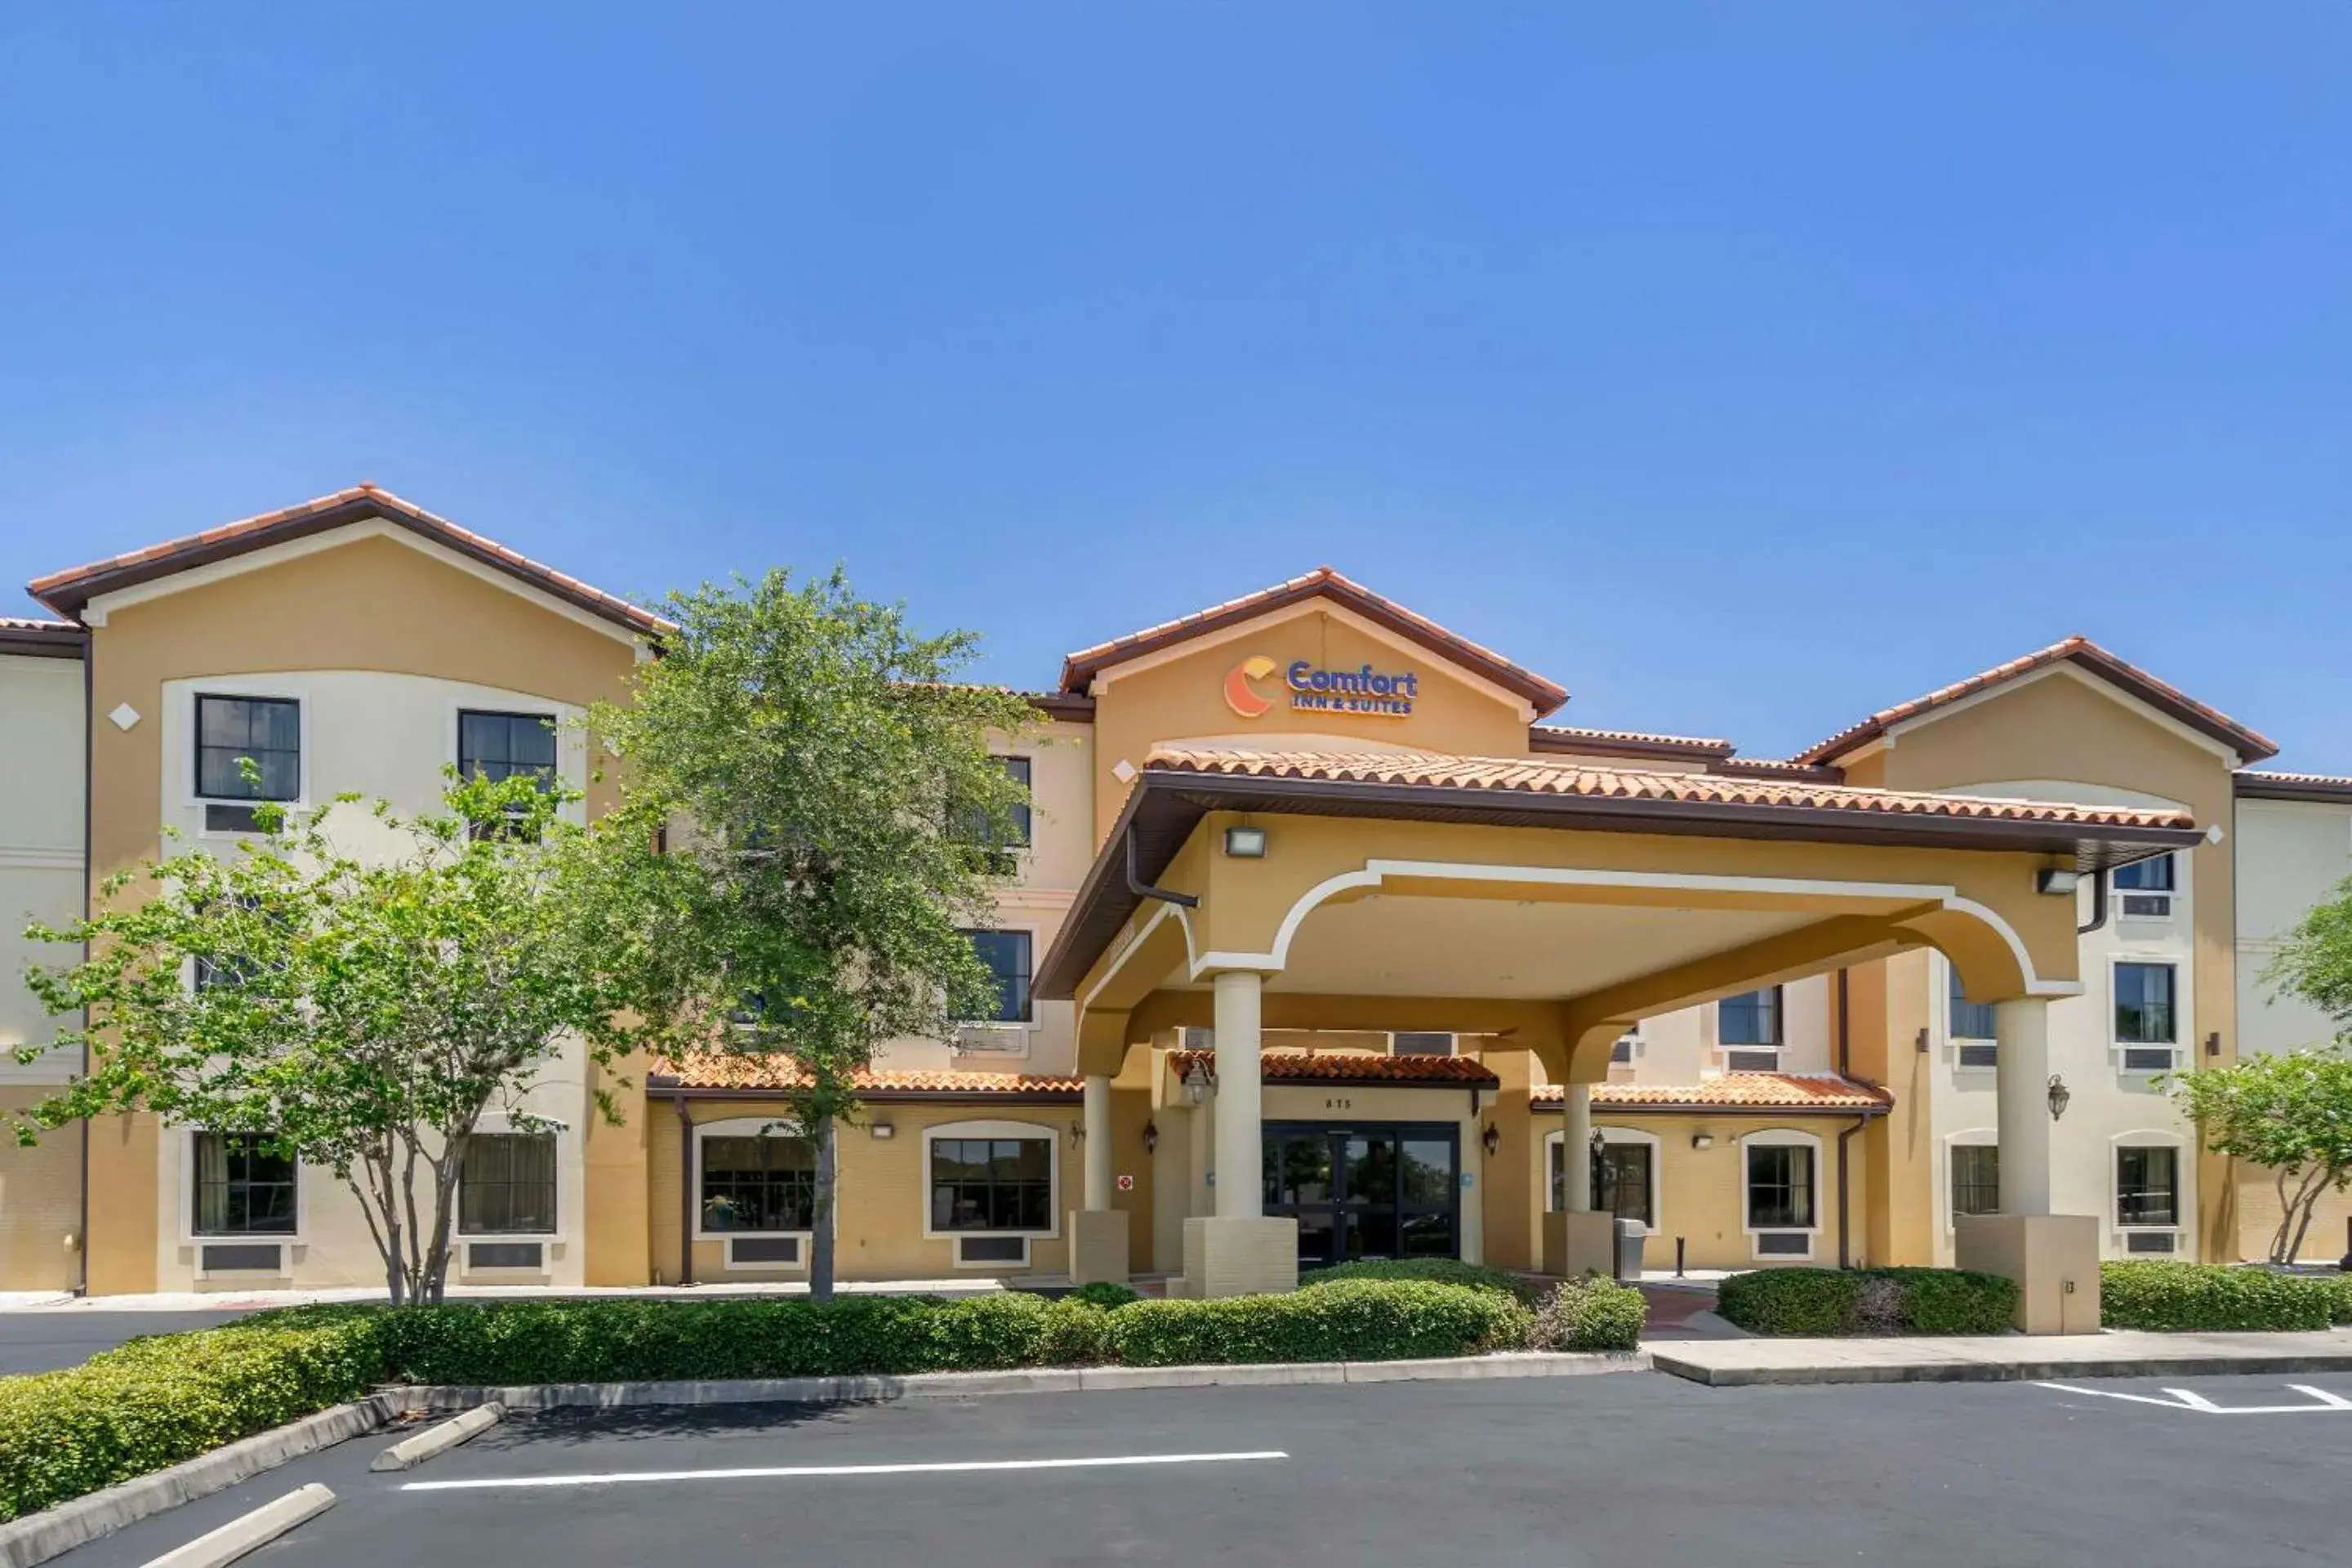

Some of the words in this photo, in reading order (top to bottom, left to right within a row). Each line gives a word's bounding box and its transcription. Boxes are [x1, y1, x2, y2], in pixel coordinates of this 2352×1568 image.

[1287, 660, 1418, 698] Comfort
[1292, 694, 1328, 710] INN
[1332, 697, 1344, 711] &
[1349, 697, 1412, 715] SUITES
